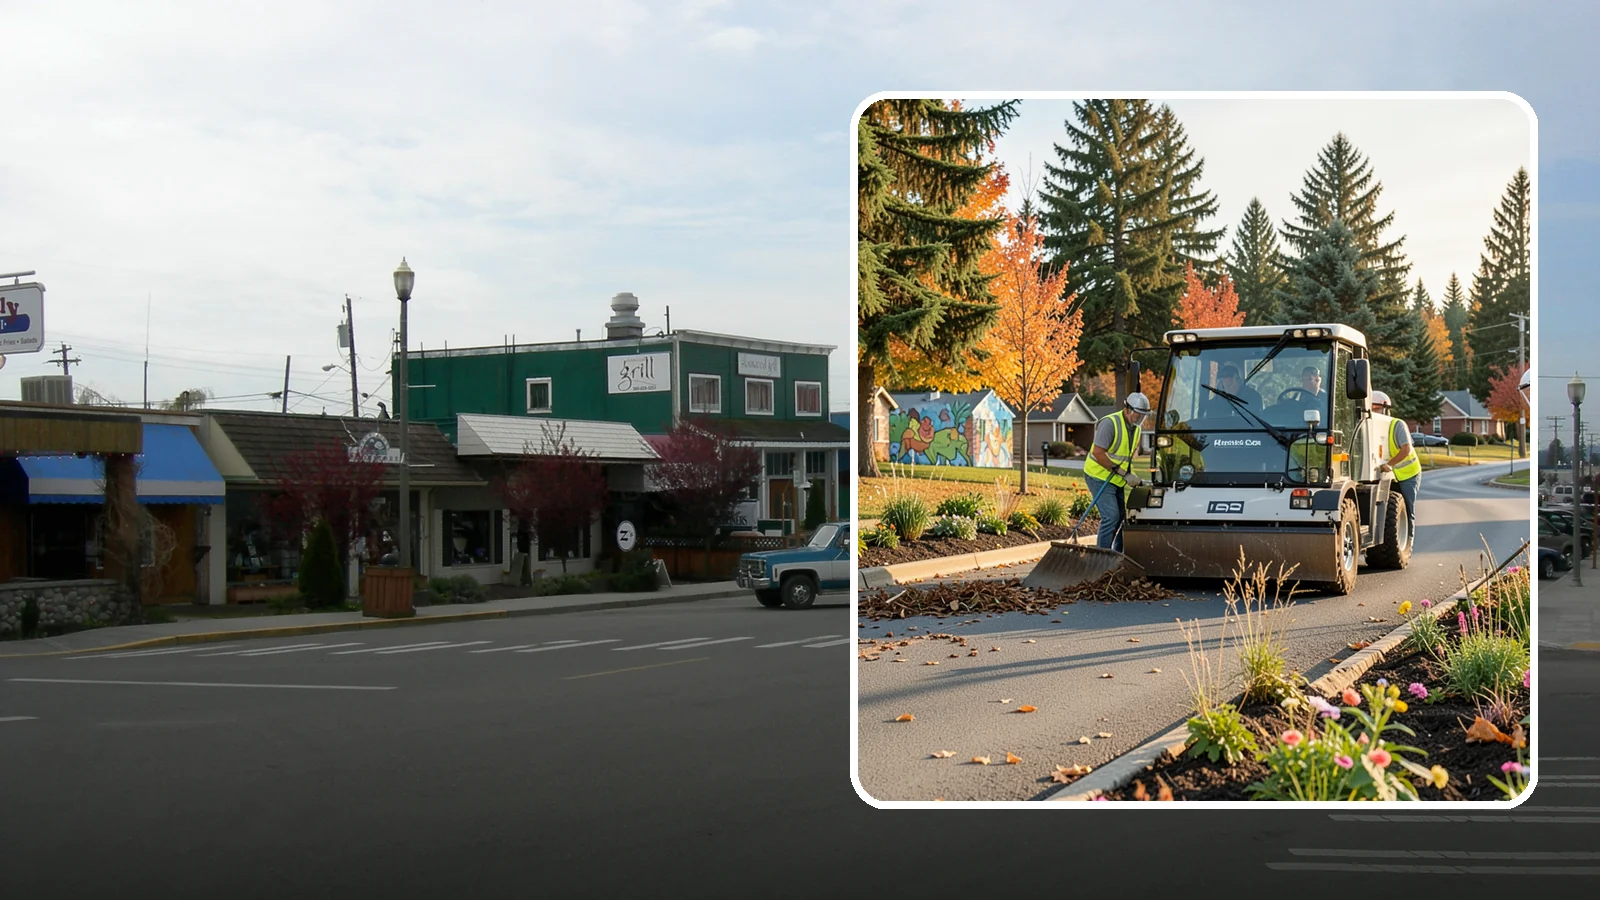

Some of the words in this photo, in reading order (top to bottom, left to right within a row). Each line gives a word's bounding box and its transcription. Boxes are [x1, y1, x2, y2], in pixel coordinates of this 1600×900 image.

[3, 338, 16, 346] Fries
[20, 337, 38, 345] Salads
[618, 356, 655, 391] grill
